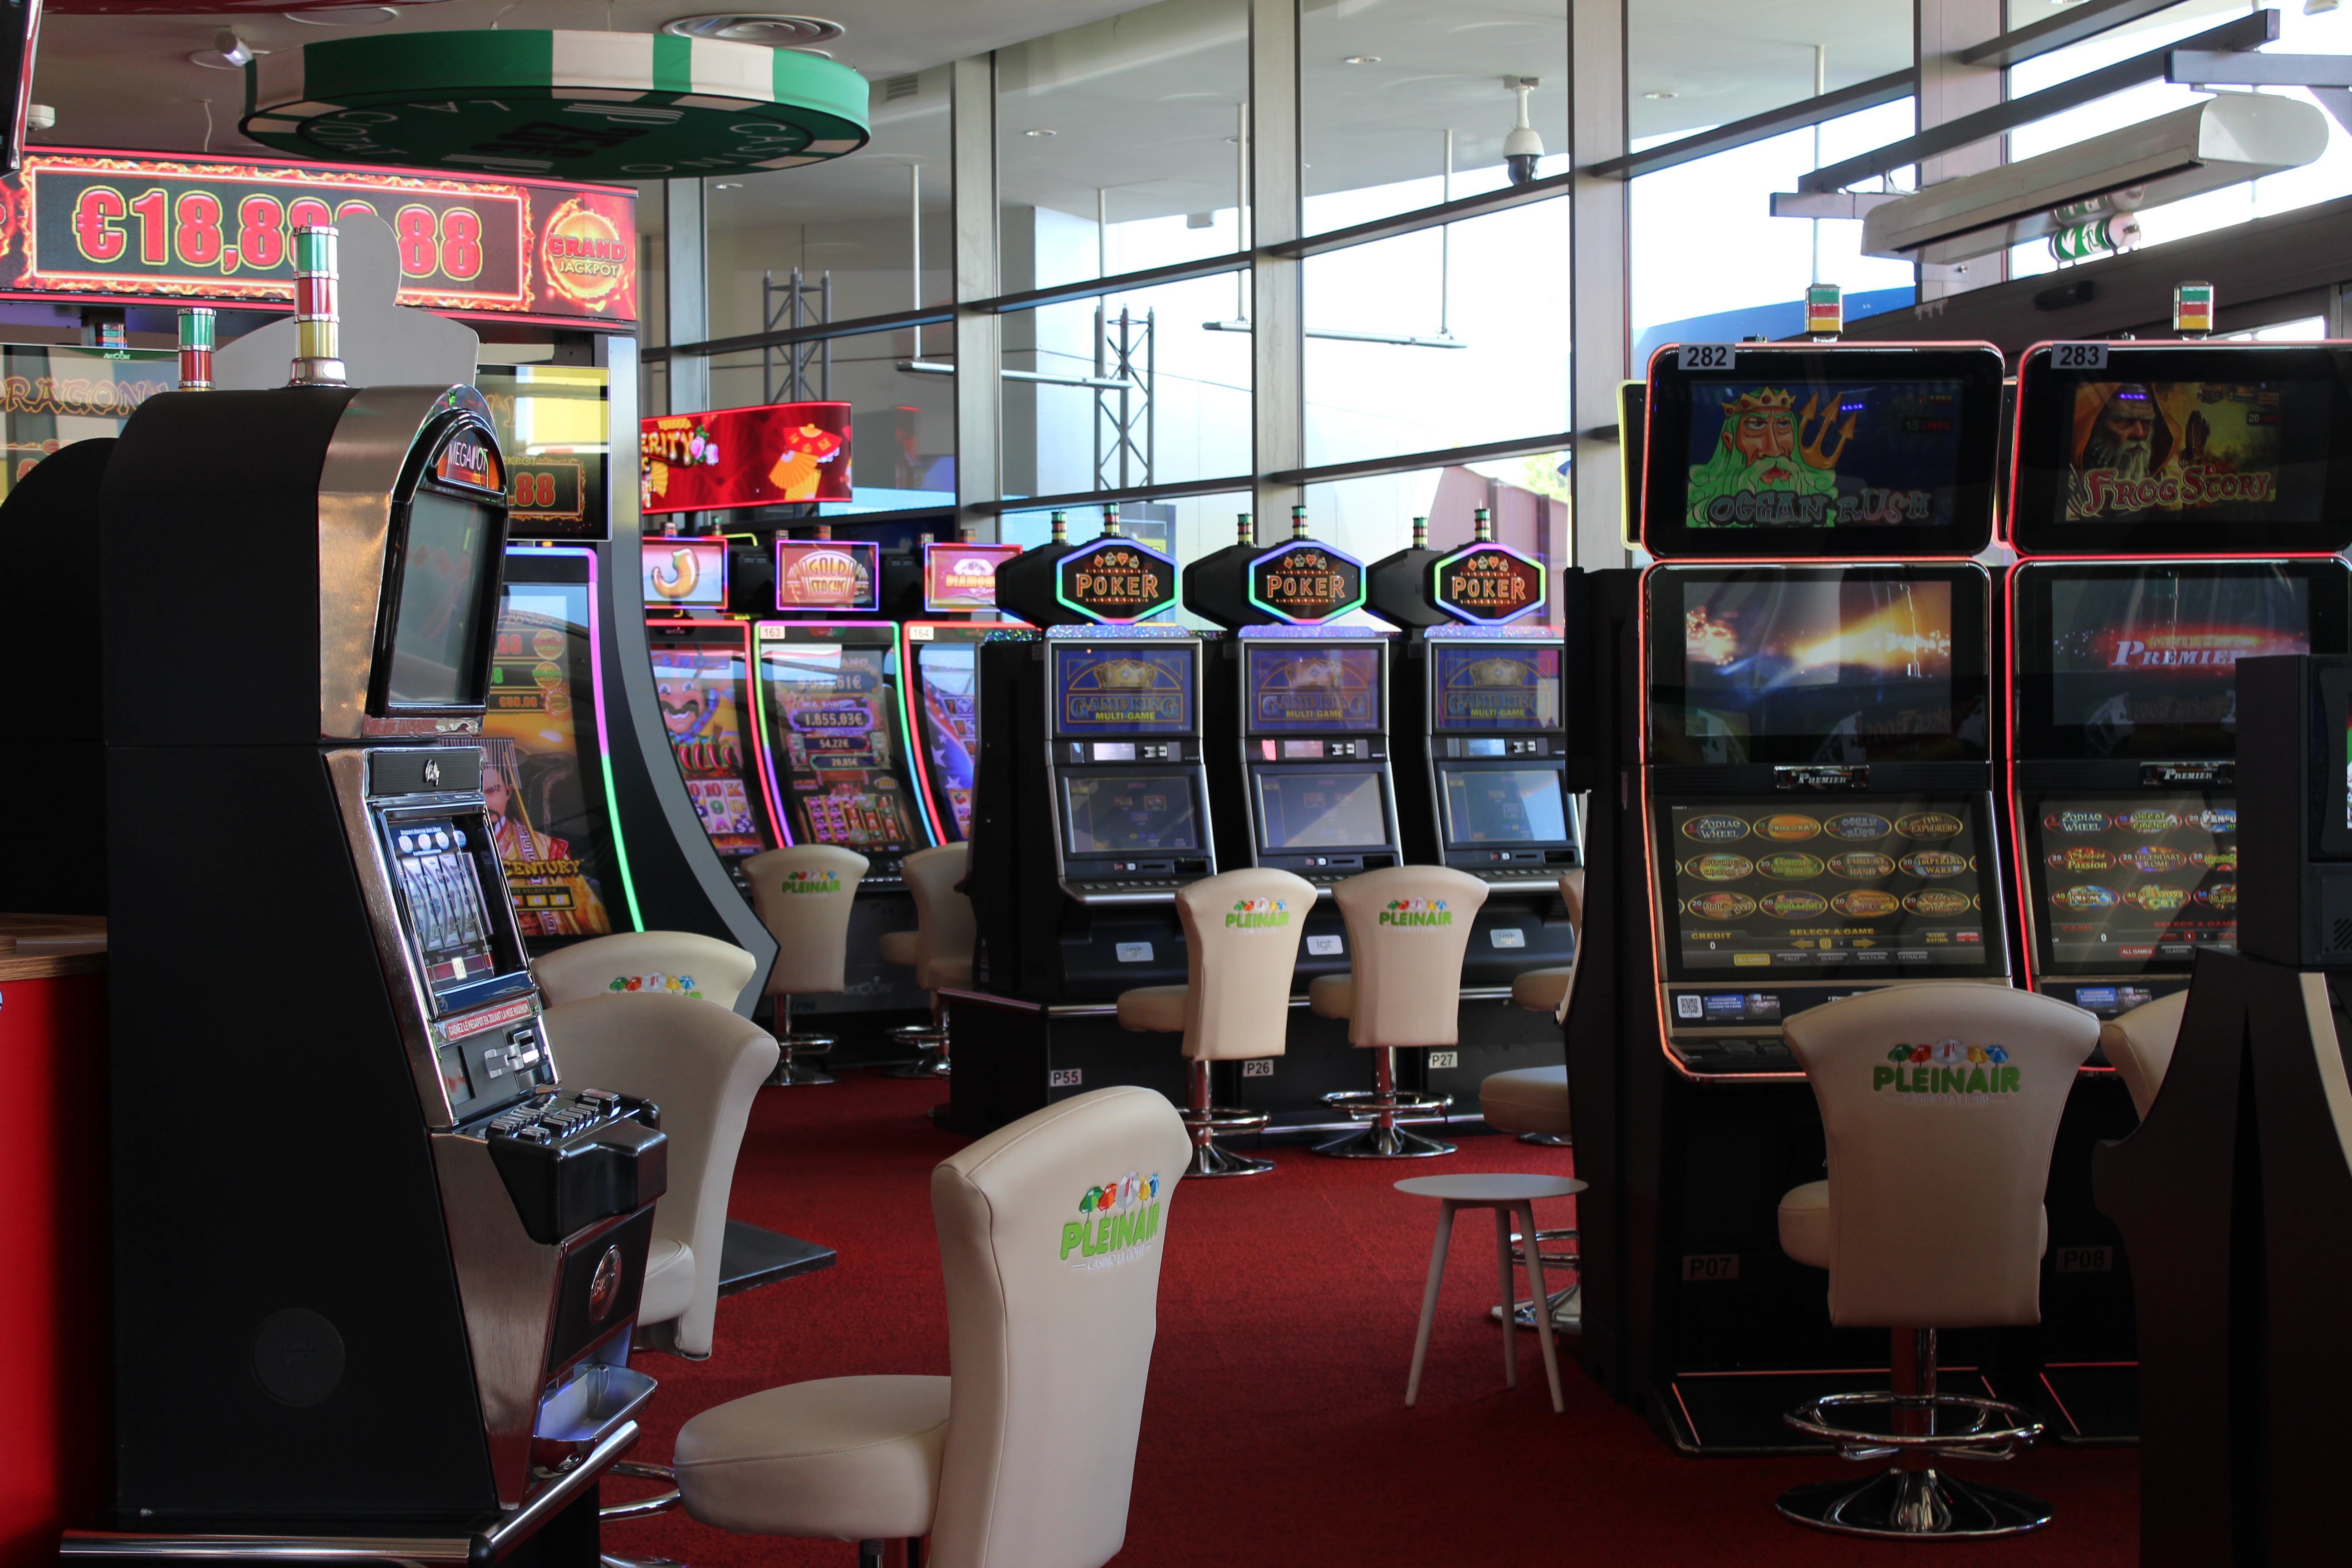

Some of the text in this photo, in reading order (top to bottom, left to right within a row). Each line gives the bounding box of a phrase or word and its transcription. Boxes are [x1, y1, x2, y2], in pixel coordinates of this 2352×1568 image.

[548, 235, 626, 262] GRAND
[559, 261, 618, 277] JACKPOT
[1686, 346, 1727, 367] 282
[2059, 345, 2100, 366] 283
[2249, 414, 2259, 422] 20
[1906, 420, 1919, 430] 15
[2083, 466, 2270, 516] FROG STORY
[1709, 489, 1931, 524] OCEAN RUSH
[809, 557, 847, 576] GOLD
[1076, 573, 1159, 598] POKER
[1266, 575, 1345, 598] POKER
[1452, 576, 1526, 600] POKER
[764, 627, 781, 637] 163
[913, 629, 929, 637] 164
[1071, 696, 1178, 719] GAME KING
[1262, 695, 1368, 716] GAME KING
[1447, 695, 1500, 716] GAME
[1095, 711, 1155, 720] MULTI-GAME
[1286, 709, 1343, 719] MULTI-GAME
[1470, 708, 1525, 717] MULTI-GAME
[1798, 772, 1847, 784] PREMIER
[2164, 769, 2213, 779] PREMIER
[1700, 819, 1741, 829] ZODIAC
[2062, 813, 2102, 822] ZODIAC
[2203, 815, 2236, 823] PENGU
[1701, 829, 1739, 838] WHEEL
[1911, 824, 1957, 833] EXPLORERS
[2063, 822, 2101, 832] WHEEL
[503, 860, 580, 877] CENTURY
[1917, 858, 1962, 866] IMPERIAL
[2068, 861, 2107, 869] Passion
[782, 878, 840, 894] PLEINAIR
[1225, 910, 1289, 928] PLEINAIR
[1379, 911, 1452, 926] PLEINAIR
[1501, 933, 1516, 944] igt
[2101, 934, 2107, 942] 0
[1126, 946, 1143, 957] igt
[1316, 939, 1333, 951] igt
[1710, 941, 1715, 950] 0
[448, 1003, 529, 1036] GAGNEZ LE MEGAPOT EN JOUANT LA MISE MAXIMUM
[1432, 1054, 1454, 1067] P27
[1247, 1062, 1270, 1075] P26
[1053, 1071, 1078, 1084] P55
[1873, 1066, 2020, 1094] PLEINAIR
[1905, 1095, 1941, 1103] CASINO
[1060, 1202, 1160, 1260] PLEINAIR
[1088, 1245, 1146, 1271] CASINO LA CIOTAT
[2063, 1250, 2104, 1269] P08
[1690, 1258, 1732, 1277] P07
